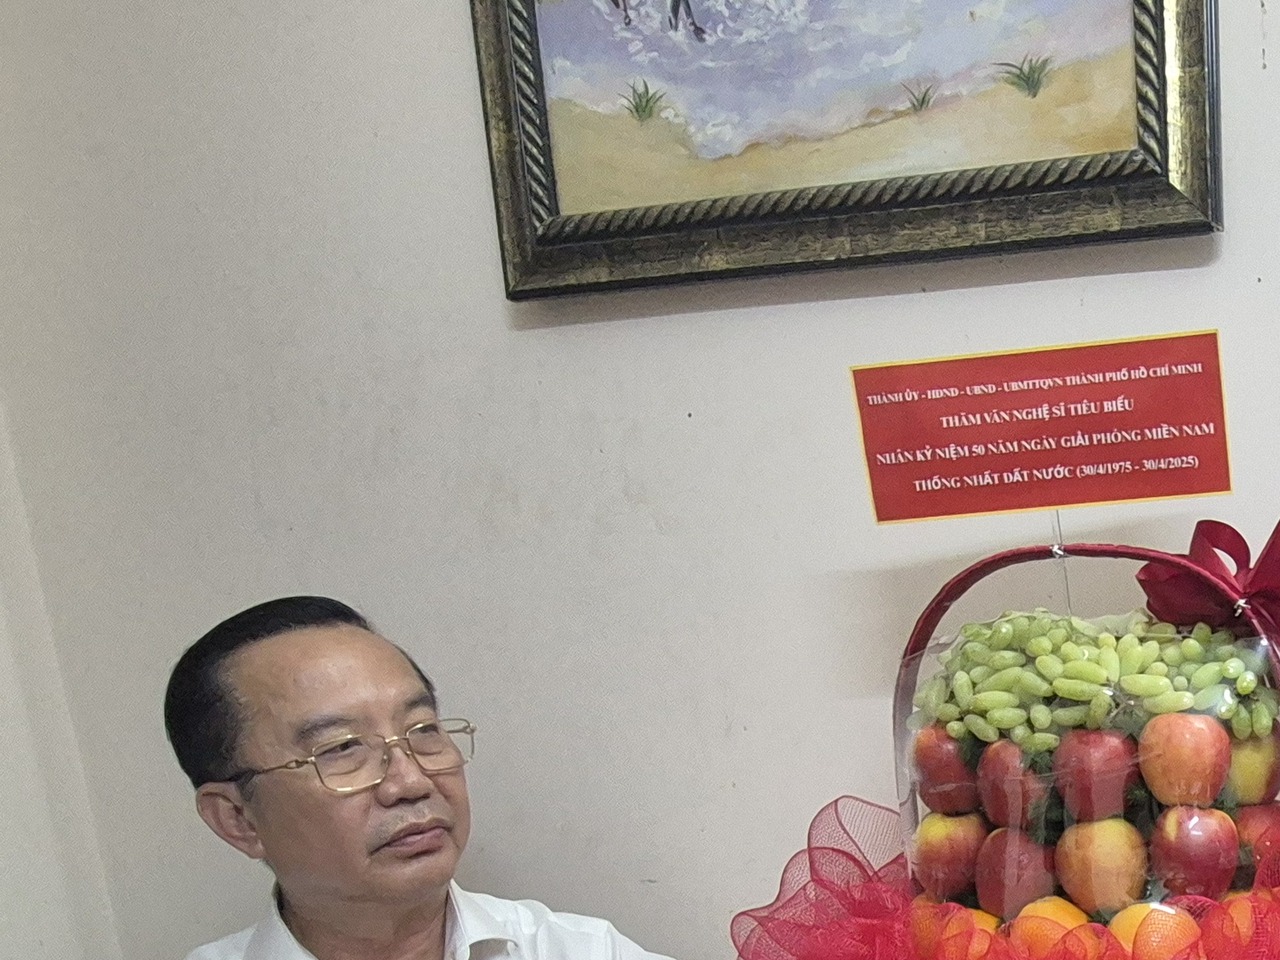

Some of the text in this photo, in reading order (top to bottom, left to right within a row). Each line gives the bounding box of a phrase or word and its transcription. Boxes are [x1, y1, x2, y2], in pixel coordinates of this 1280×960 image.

[867, 392, 902, 405] THÀNH
[966, 384, 996, 396] UBND
[1066, 372, 1103, 386] THÀNH
[1106, 368, 1128, 382] PHỐ
[1131, 366, 1148, 380] HỒ
[1149, 364, 1169, 377] CHÍ
[1171, 363, 1202, 374] MINH
[940, 395, 1134, 428] THĂM VĂN NGHỆ SĨ TIÊU BIỂU
[876, 449, 914, 464] NHÂN
[936, 444, 969, 460] NIỆM
[972, 445, 985, 456] 50
[988, 440, 1018, 454] NĂM
[1021, 435, 1058, 451] NGÀY
[1061, 431, 1089, 447] GIẢI
[1092, 428, 1141, 445] PHÓNG
[1144, 423, 1179, 440] MIỀN
[1183, 422, 1214, 435] NAM
[913, 475, 960, 492] THỐNG
[963, 470, 1000, 486] NHẤT
[1033, 466, 1075, 480] NƯỚC
[1076, 461, 1132, 478] (30/4/1975
[1142, 455, 1199, 470] 30/4/2025)
